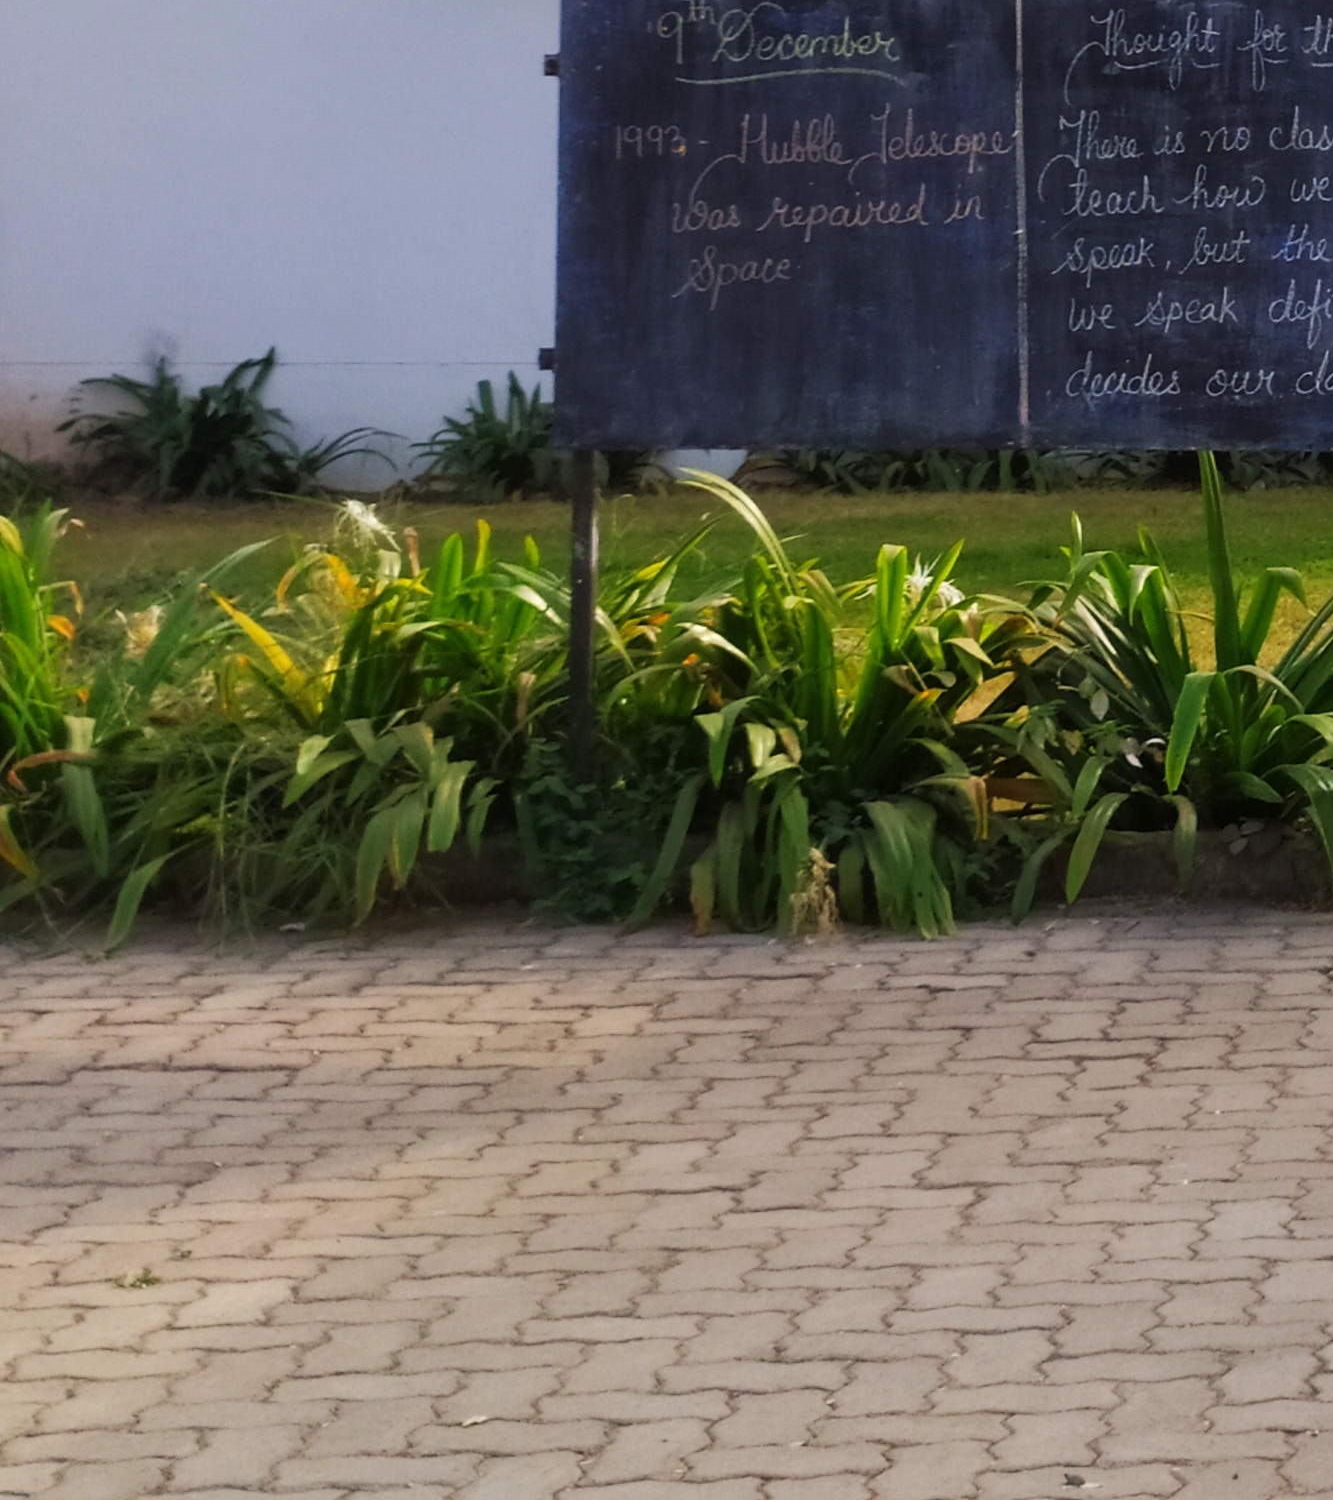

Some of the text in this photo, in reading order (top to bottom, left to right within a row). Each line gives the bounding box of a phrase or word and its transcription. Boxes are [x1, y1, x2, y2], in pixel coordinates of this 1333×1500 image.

[712, 2, 900, 62] December
[1070, 8, 1222, 98] Thought
[1238, 9, 1289, 91] for
[700, 113, 854, 190] Hubble
[852, 103, 1017, 180] Telescope
[1154, 125, 1186, 155] is
[1201, 128, 1250, 153] no
[756, 184, 930, 243] repaired
[944, 186, 986, 225] in
[1068, 168, 1163, 216] teach
[1174, 154, 1267, 208] how
[1290, 176, 1332, 202] we
[1179, 227, 1250, 275] but
[1068, 297, 1116, 331] we
[1135, 287, 1239, 333] speak
[1066, 351, 1182, 399] decides
[1205, 366, 1274, 397] our
